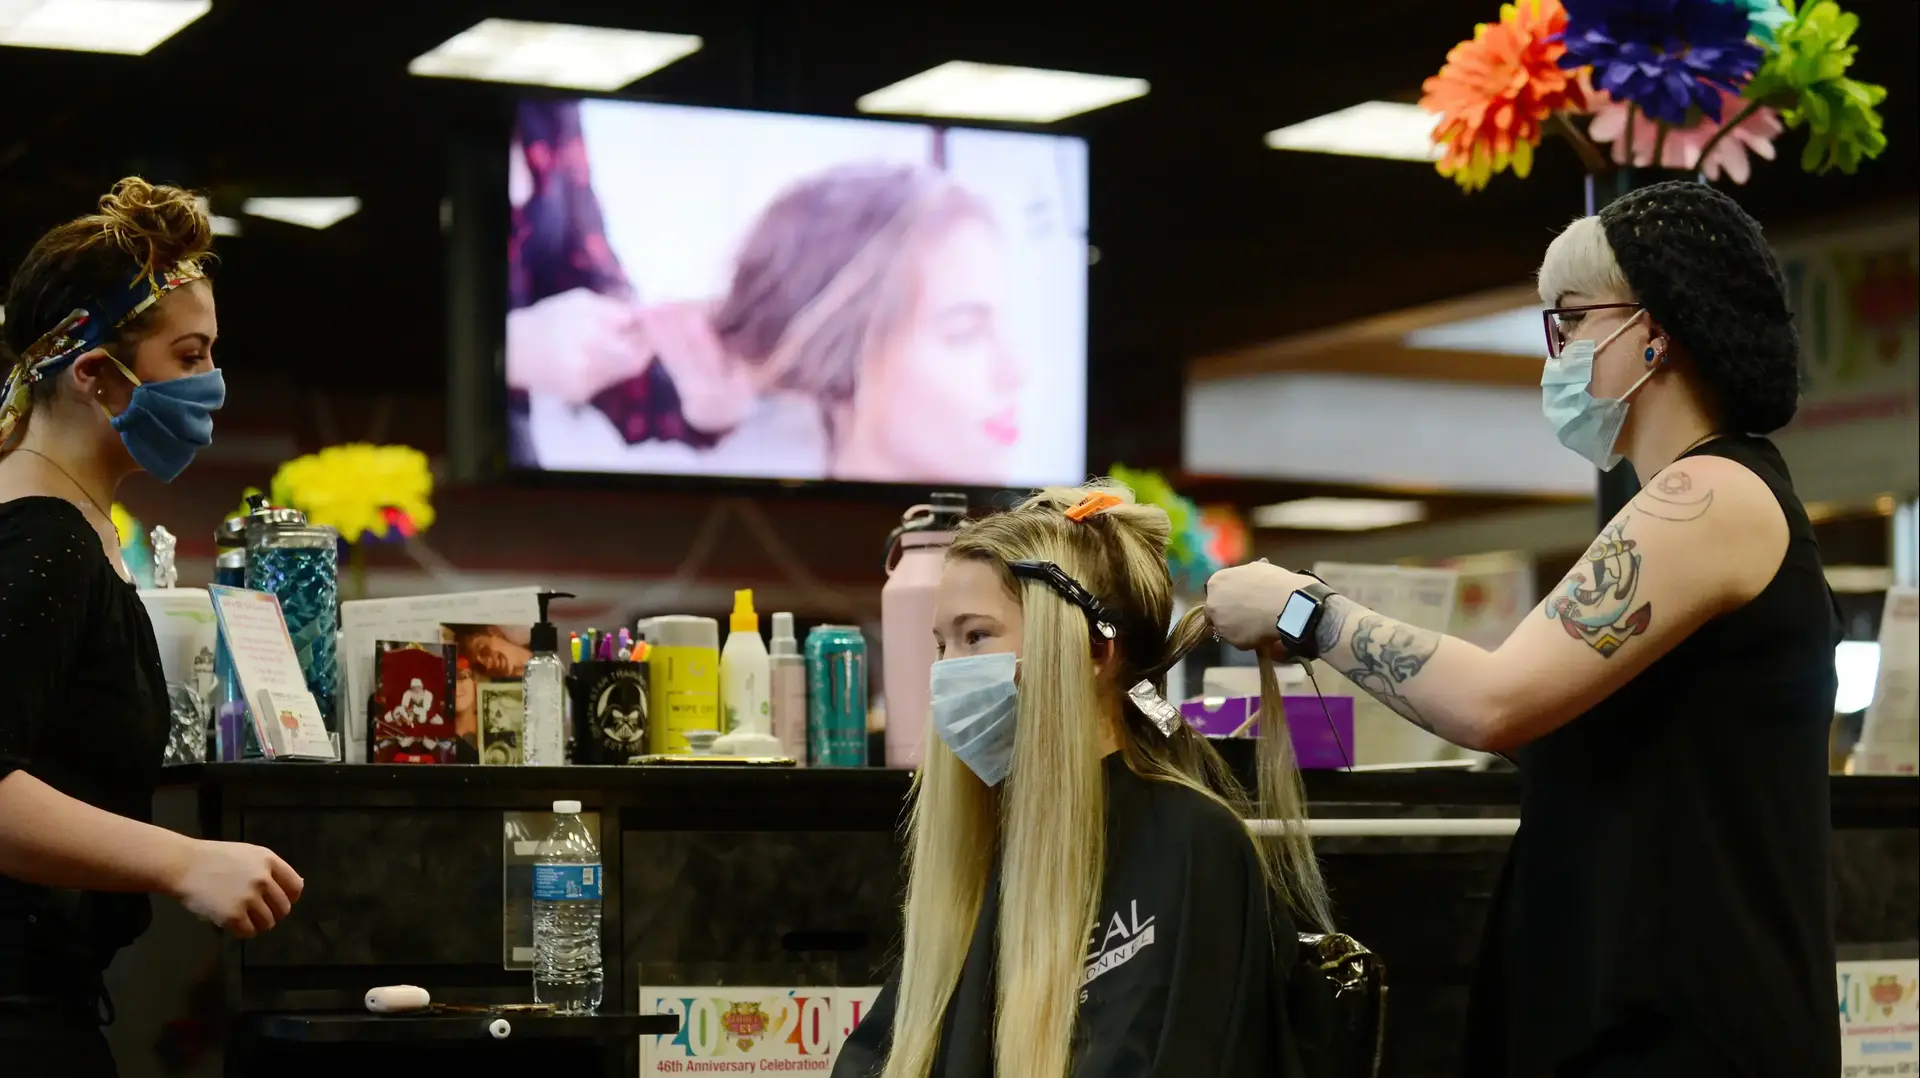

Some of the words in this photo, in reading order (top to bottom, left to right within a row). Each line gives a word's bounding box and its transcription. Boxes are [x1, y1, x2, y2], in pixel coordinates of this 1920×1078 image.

[657, 1060, 683, 1072] 46th
[686, 1060, 756, 1073] Anniversary
[759, 1058, 830, 1071] Celebration!
